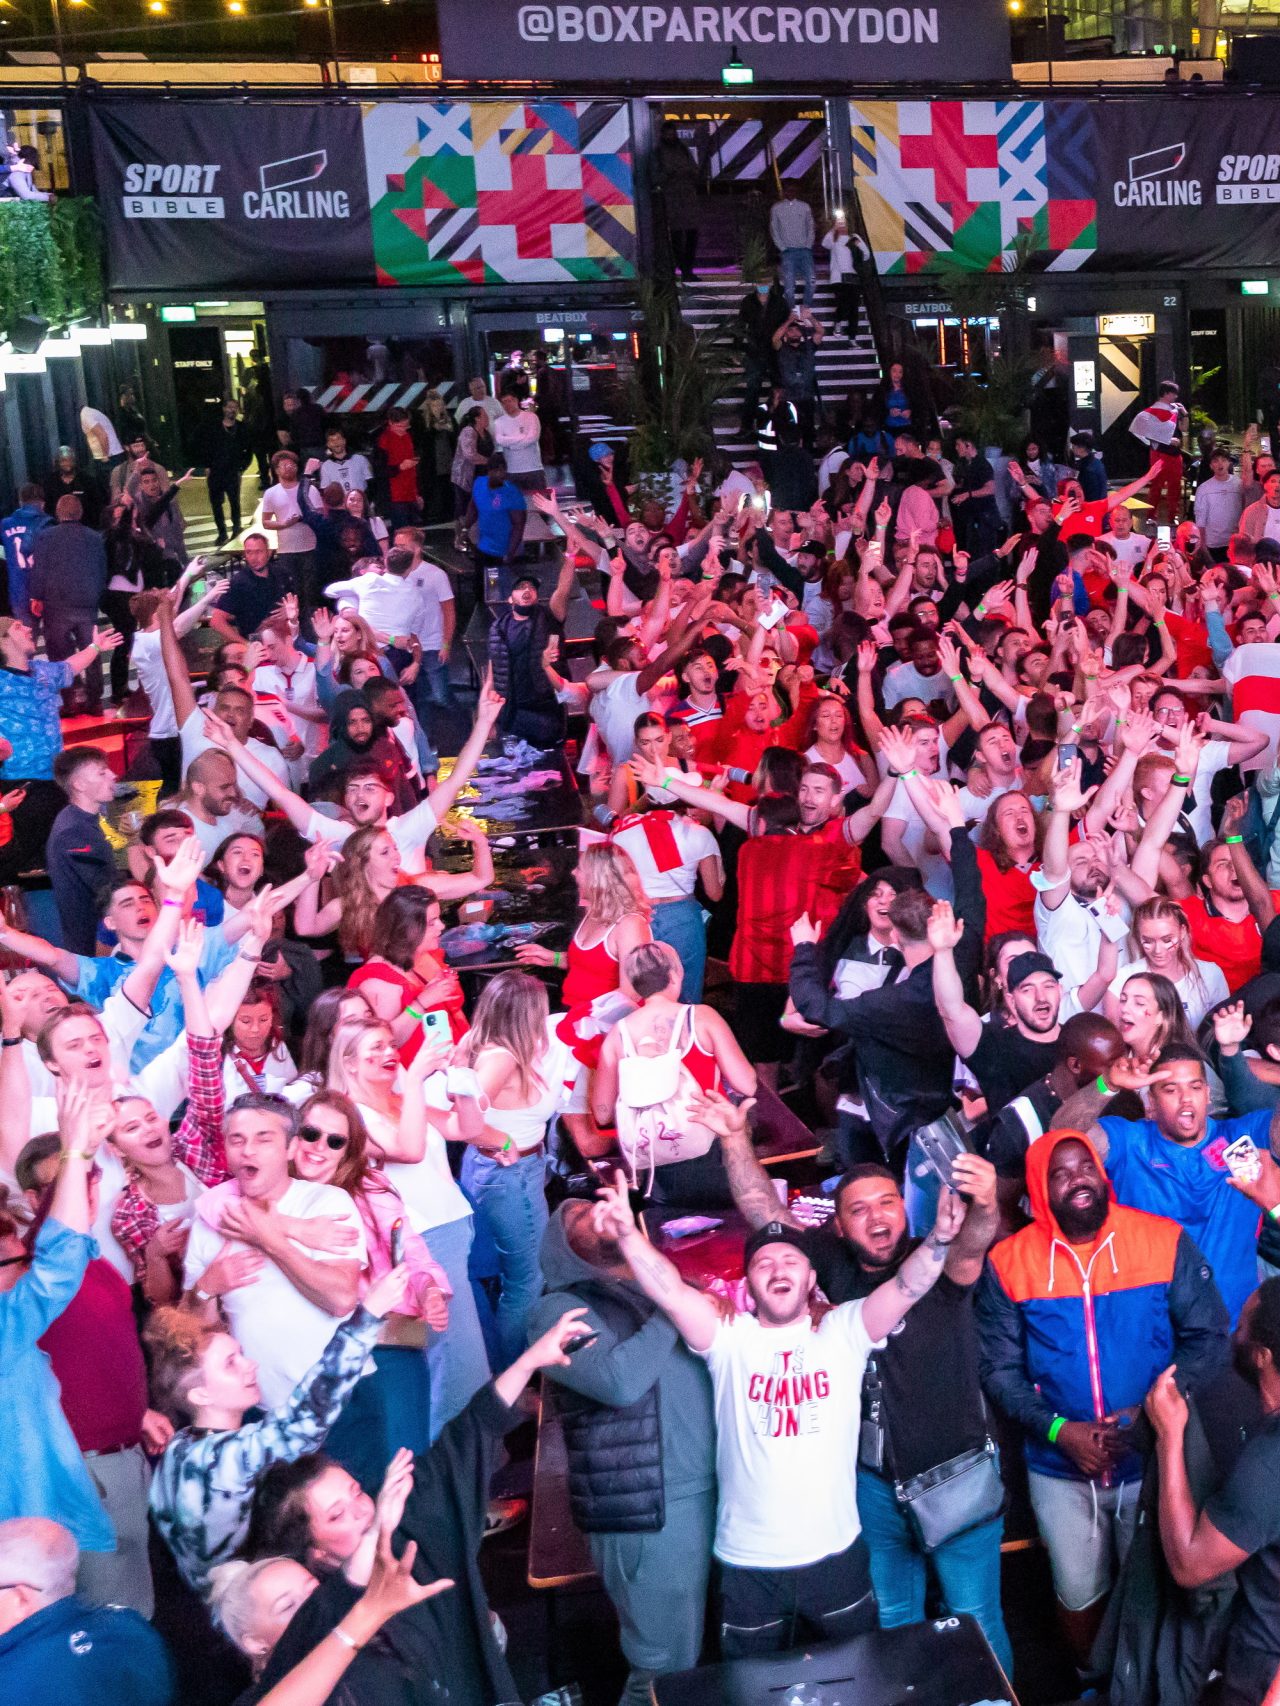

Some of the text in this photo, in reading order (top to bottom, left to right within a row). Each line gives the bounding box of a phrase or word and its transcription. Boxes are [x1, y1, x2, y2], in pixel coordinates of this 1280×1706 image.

[517, 5, 939, 43] @BOXPARKCROYDON
[123, 163, 221, 193] SPORT
[1113, 180, 1203, 207] CARLING
[131, 200, 217, 214] BIBLE
[243, 190, 350, 219] CARLING
[905, 303, 953, 314] BEATBOX
[1163, 297, 1177, 306] 22
[536, 312, 588, 324] BEATBOX
[174, 360, 213, 368] STAFF ONLY
[748, 1369, 830, 1407] COMING
[933, 1617, 961, 1630] 04
